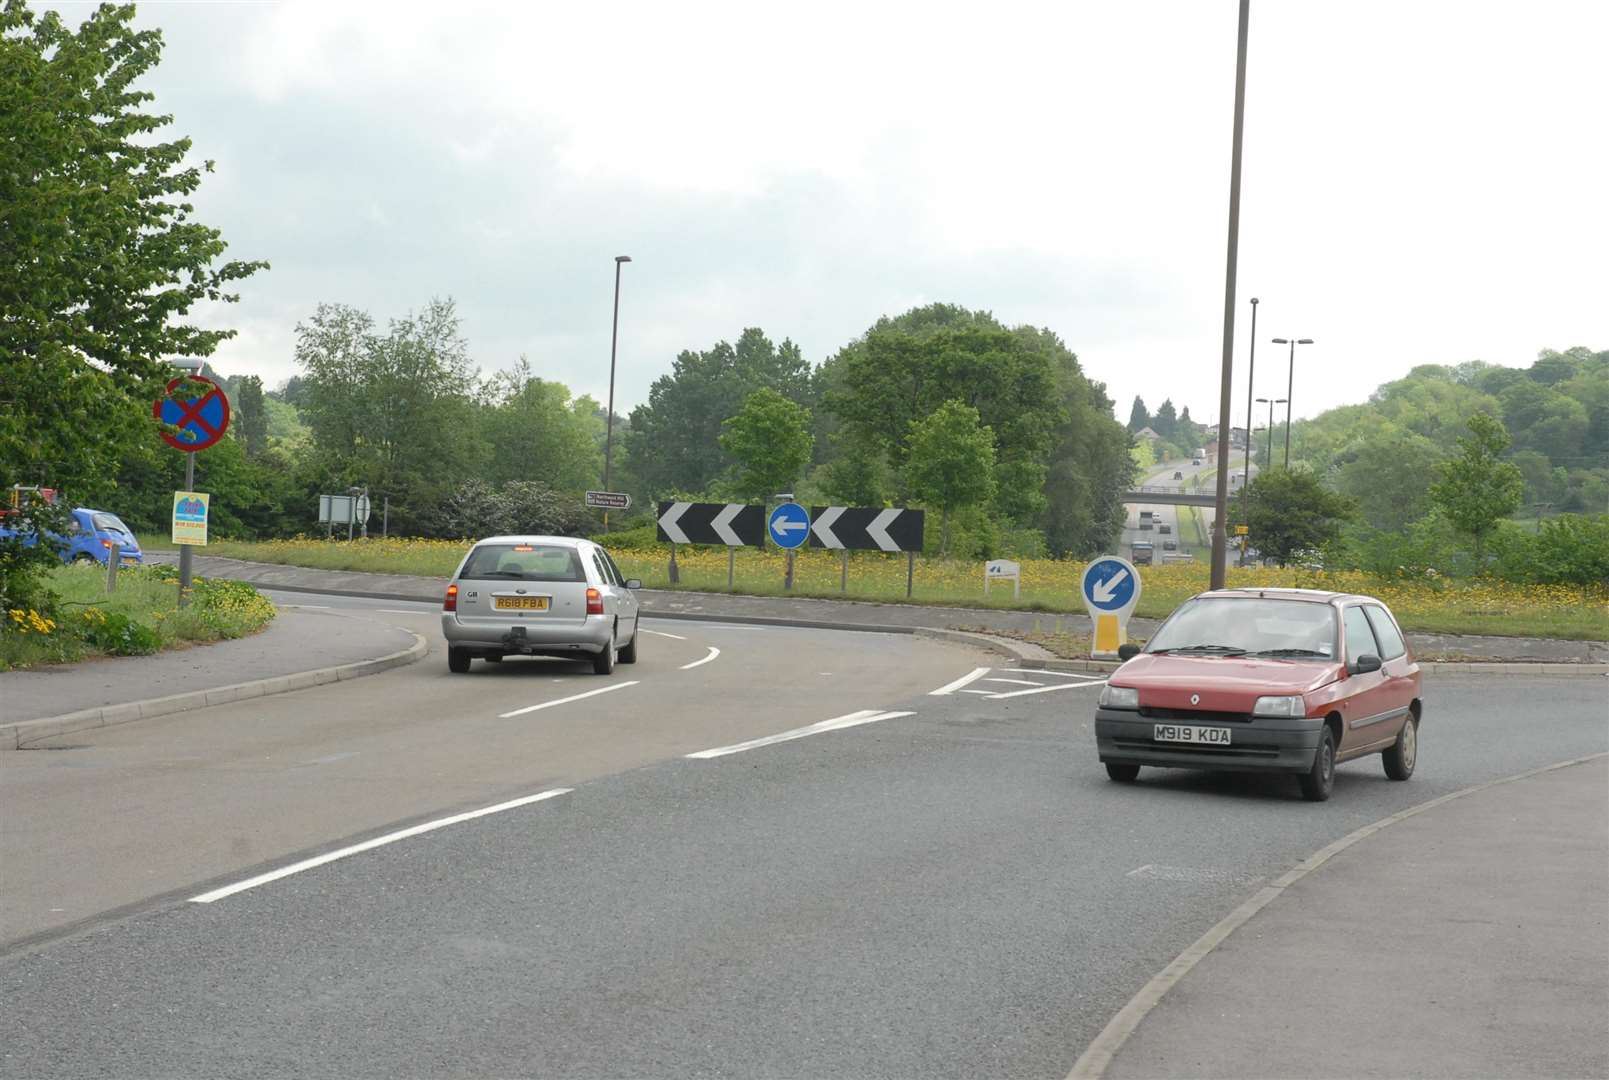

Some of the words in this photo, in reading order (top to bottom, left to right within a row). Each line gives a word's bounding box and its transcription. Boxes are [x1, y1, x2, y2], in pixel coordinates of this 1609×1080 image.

[522, 599, 544, 609] FBA
[1156, 726, 1192, 741] M919
[1199, 729, 1229, 743] KDA
